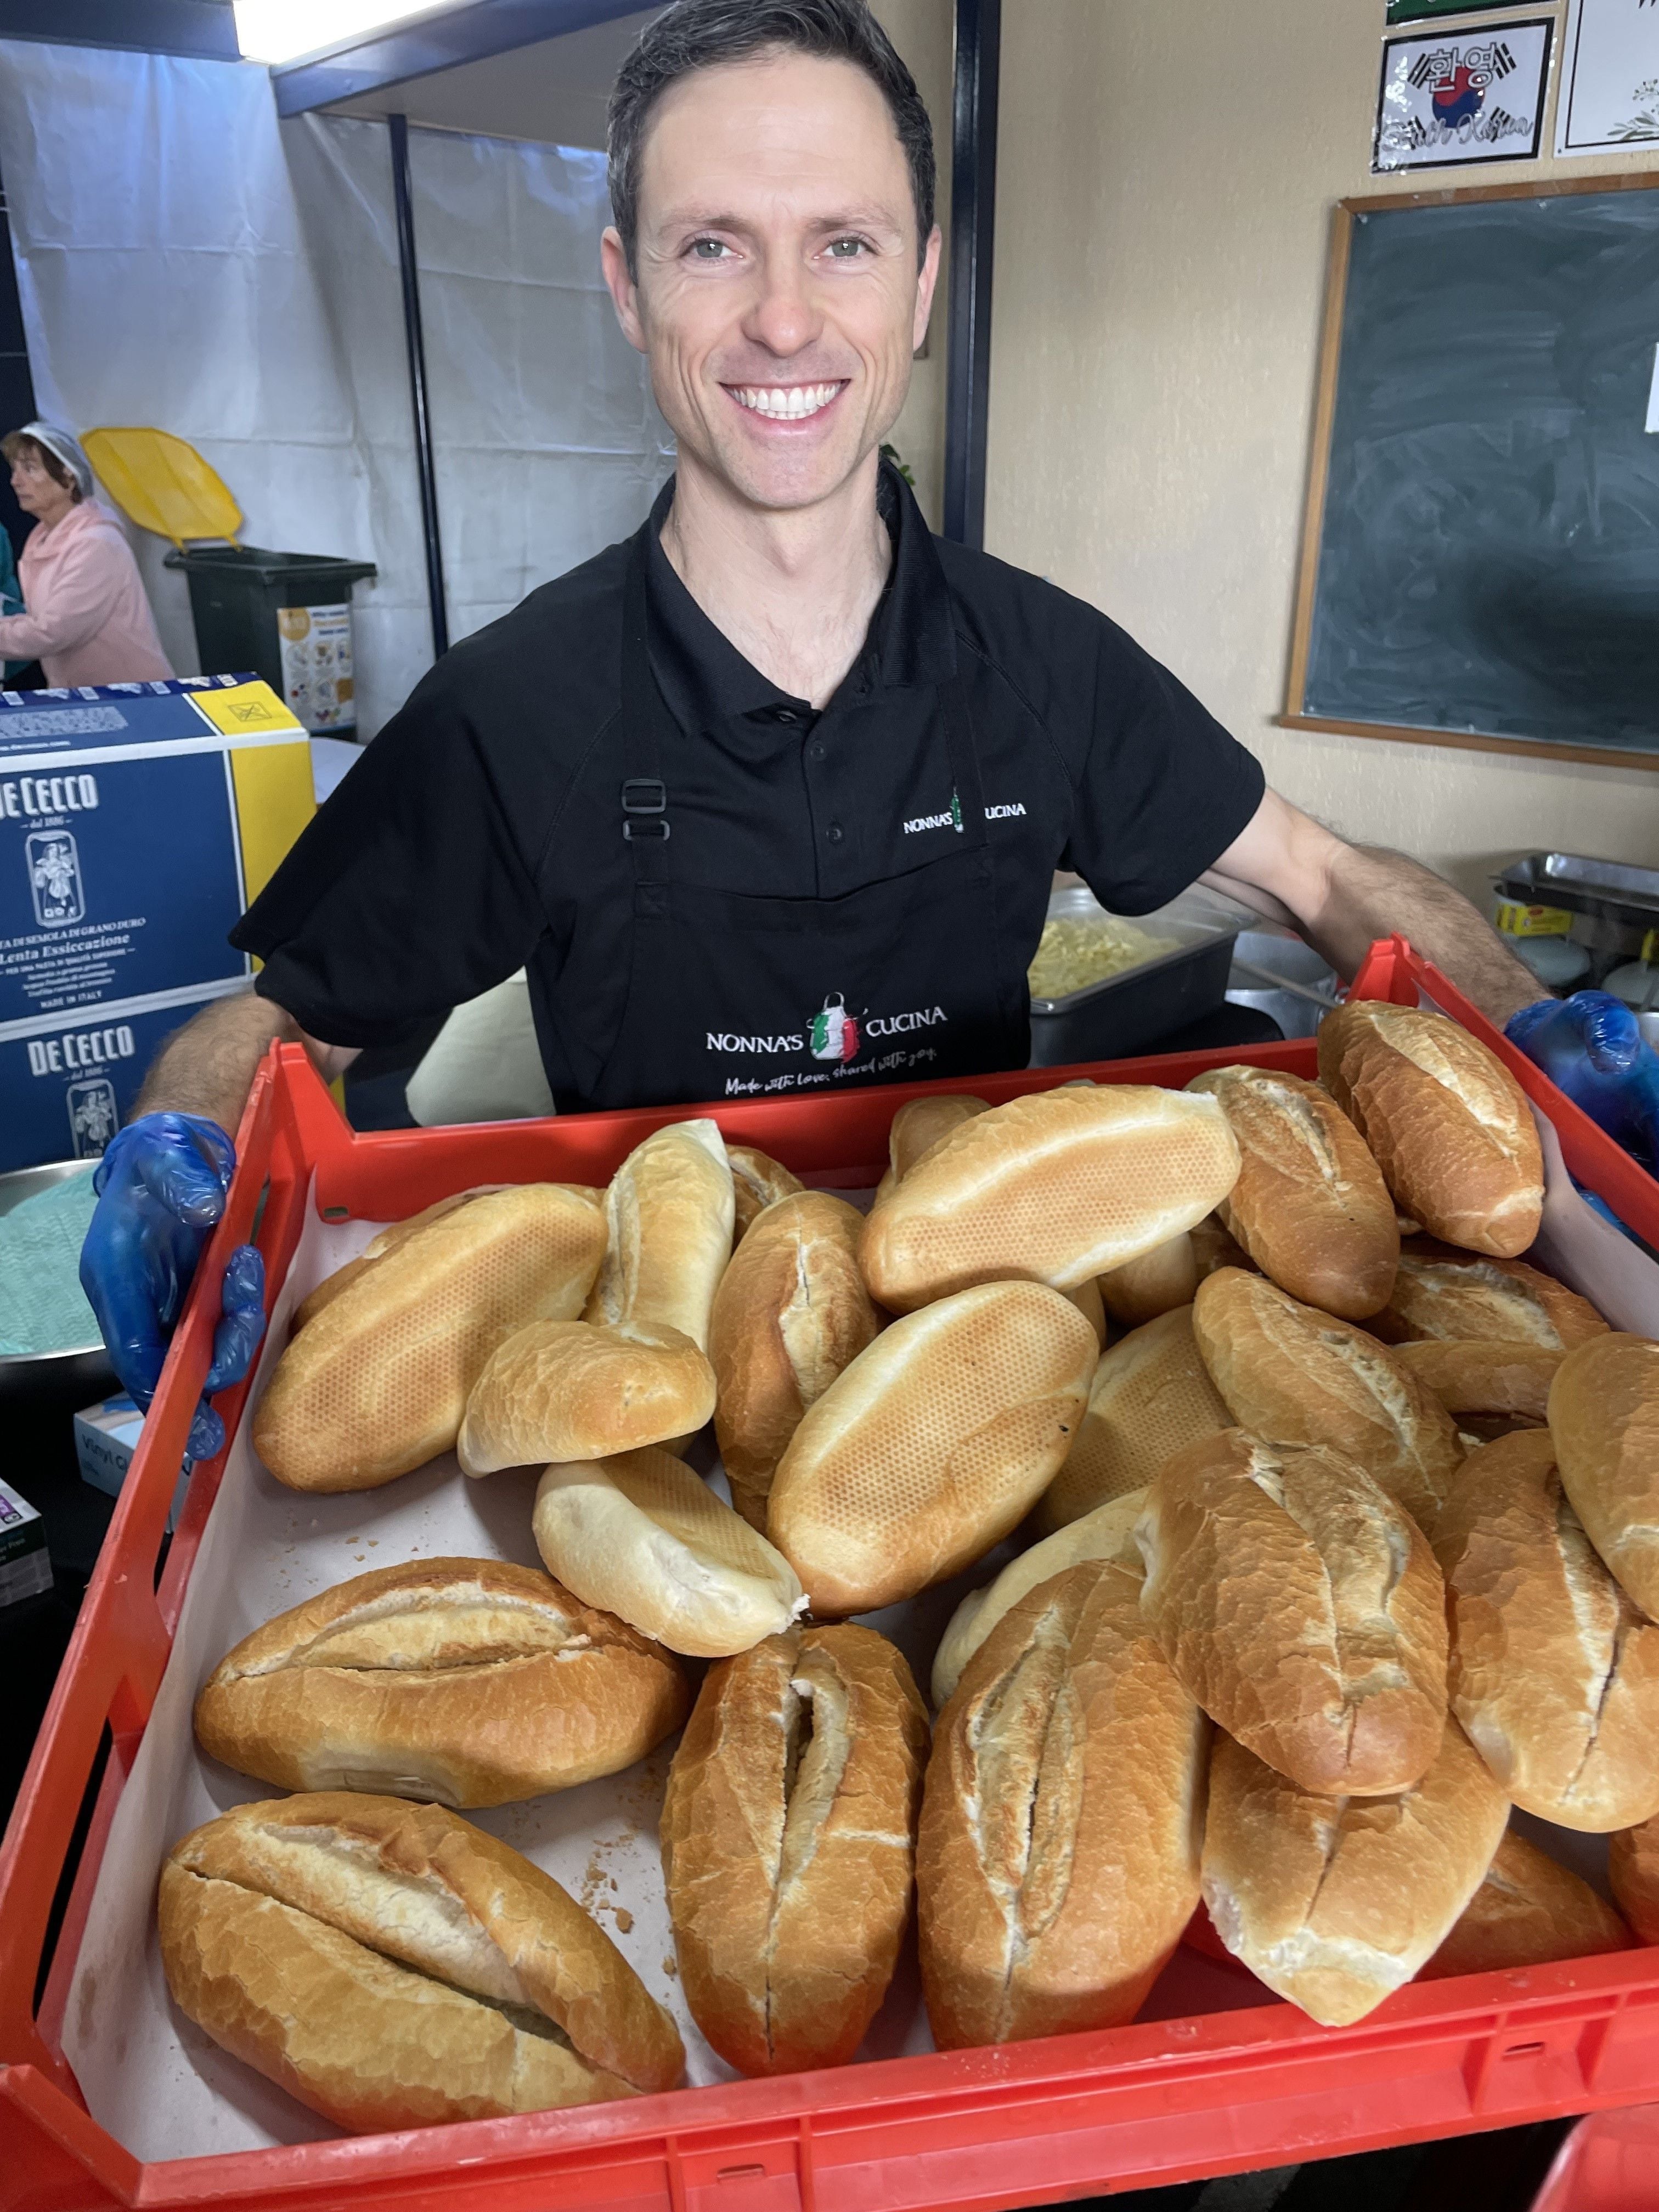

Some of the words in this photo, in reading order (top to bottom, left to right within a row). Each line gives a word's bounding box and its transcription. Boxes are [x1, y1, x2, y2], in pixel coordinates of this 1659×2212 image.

[1426, 41, 1498, 94] 환영
[20, 774, 99, 816] CECCO
[903, 811, 954, 834] NONNA'S
[43, 934, 131, 958] Essiccazione
[62, 1025, 136, 1069] CECCO
[706, 1032, 804, 1053] NONNA'S
[865, 1006, 949, 1037] CUCINA
[725, 1077, 763, 1095] Made
[764, 1074, 795, 1092] with
[832, 1057, 876, 1077] shared
